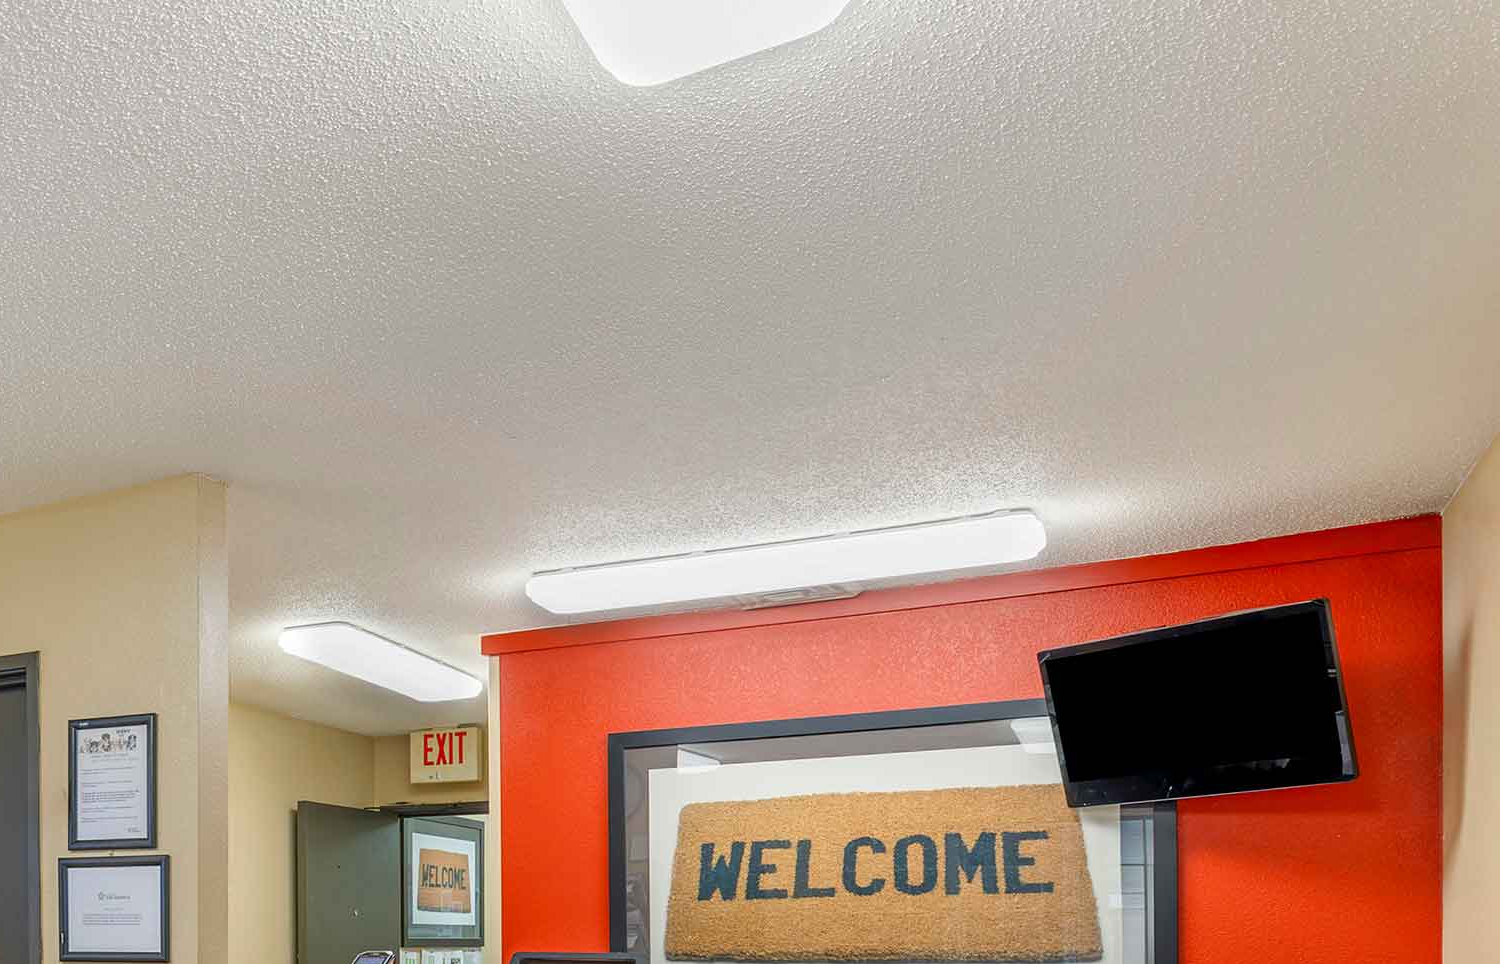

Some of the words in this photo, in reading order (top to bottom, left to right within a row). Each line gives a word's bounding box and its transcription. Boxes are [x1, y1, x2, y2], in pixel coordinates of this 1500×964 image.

[423, 731, 468, 766] EXIT
[421, 863, 467, 890] WELCOME
[697, 830, 1054, 901] WELCOME
